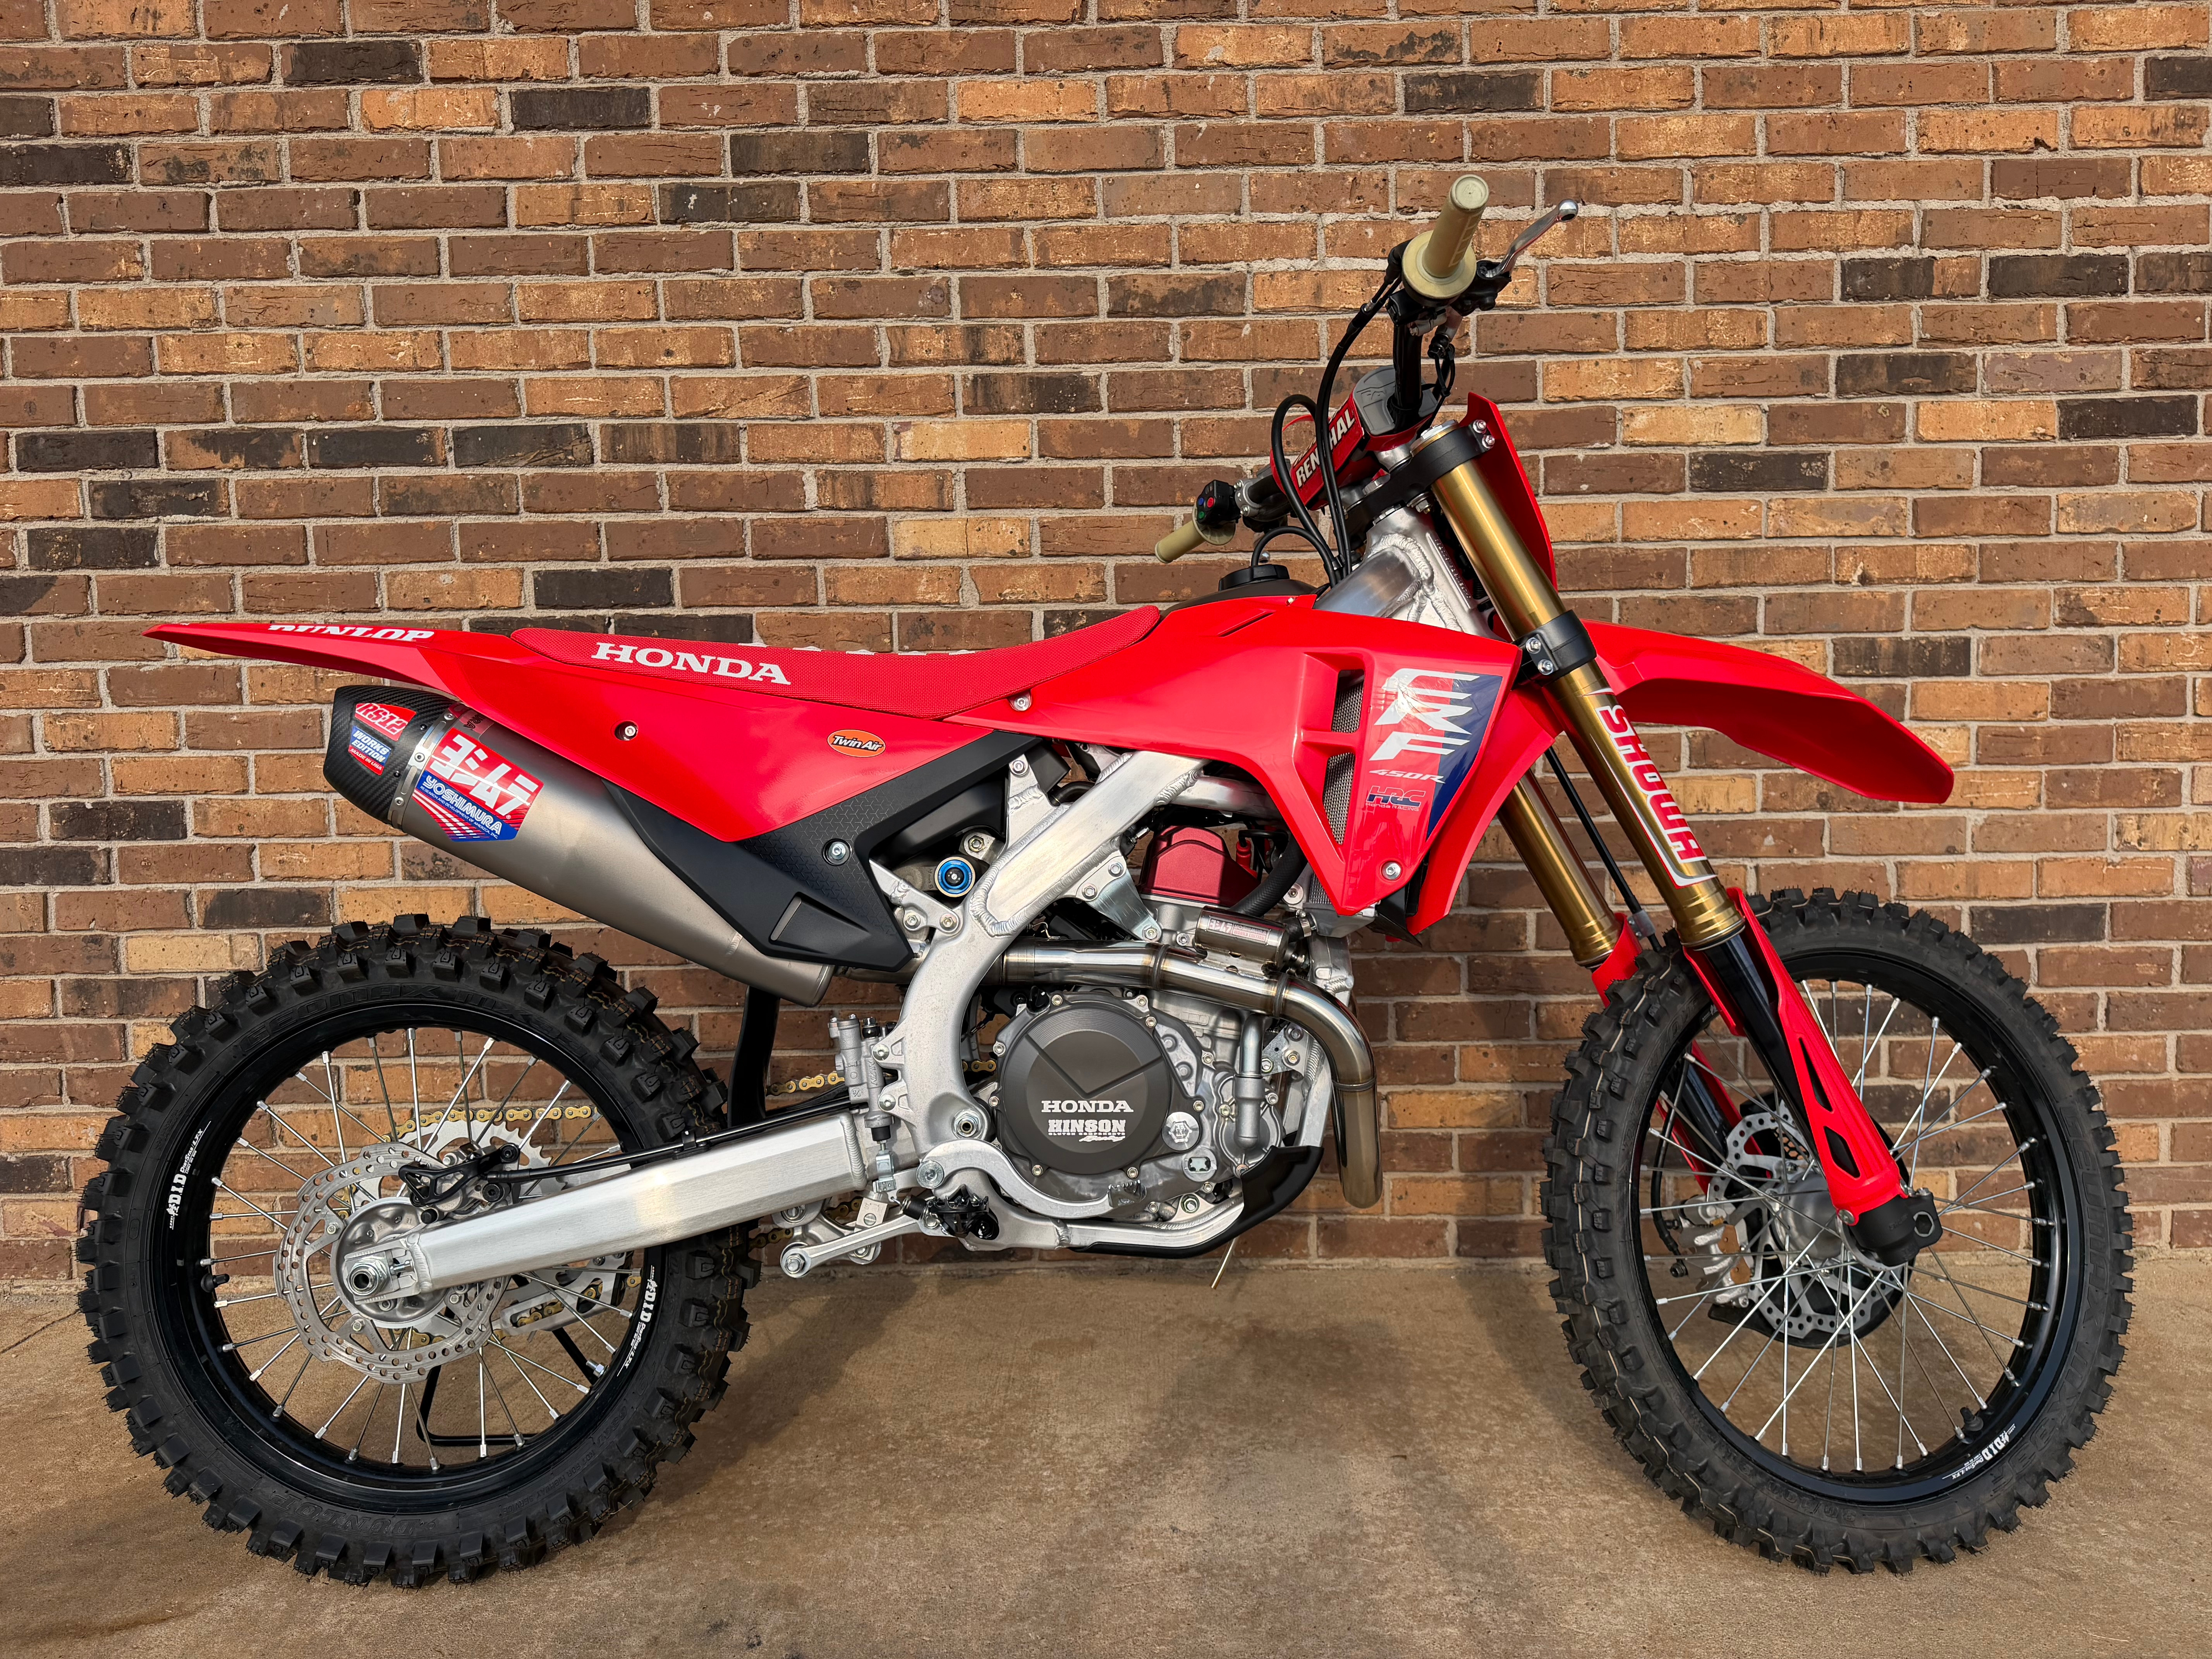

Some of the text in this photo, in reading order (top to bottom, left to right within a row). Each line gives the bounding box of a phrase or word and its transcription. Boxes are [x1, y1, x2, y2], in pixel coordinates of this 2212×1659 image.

[1296, 409, 1355, 488] RENHAL
[591, 642, 791, 685] HONDA
[1369, 668, 1480, 761] CRF
[351, 738, 386, 763] EDITION
[352, 730, 390, 755] WORKS
[833, 735, 883, 750] Twin Air
[349, 748, 366, 761] MADE
[371, 760, 383, 771] USA
[1369, 769, 1446, 784] 450R
[1595, 705, 1707, 863] SHOWA
[420, 786, 439, 800] RESEARCH
[445, 802, 470, 820] DEVELOPMENT
[422, 775, 503, 835] YOSHIMURA
[1365, 786, 1426, 807] HRC
[241, 984, 440, 1053] GEOMAX
[1041, 1100, 1134, 1113] HONDA
[1048, 1119, 1126, 1133] HINSON
[567, 1463, 581, 1476] FOR
[581, 1449, 595, 1466] NOT
[270, 1494, 420, 1536] DUNLOP
[504, 1494, 534, 1513] SERVICE
